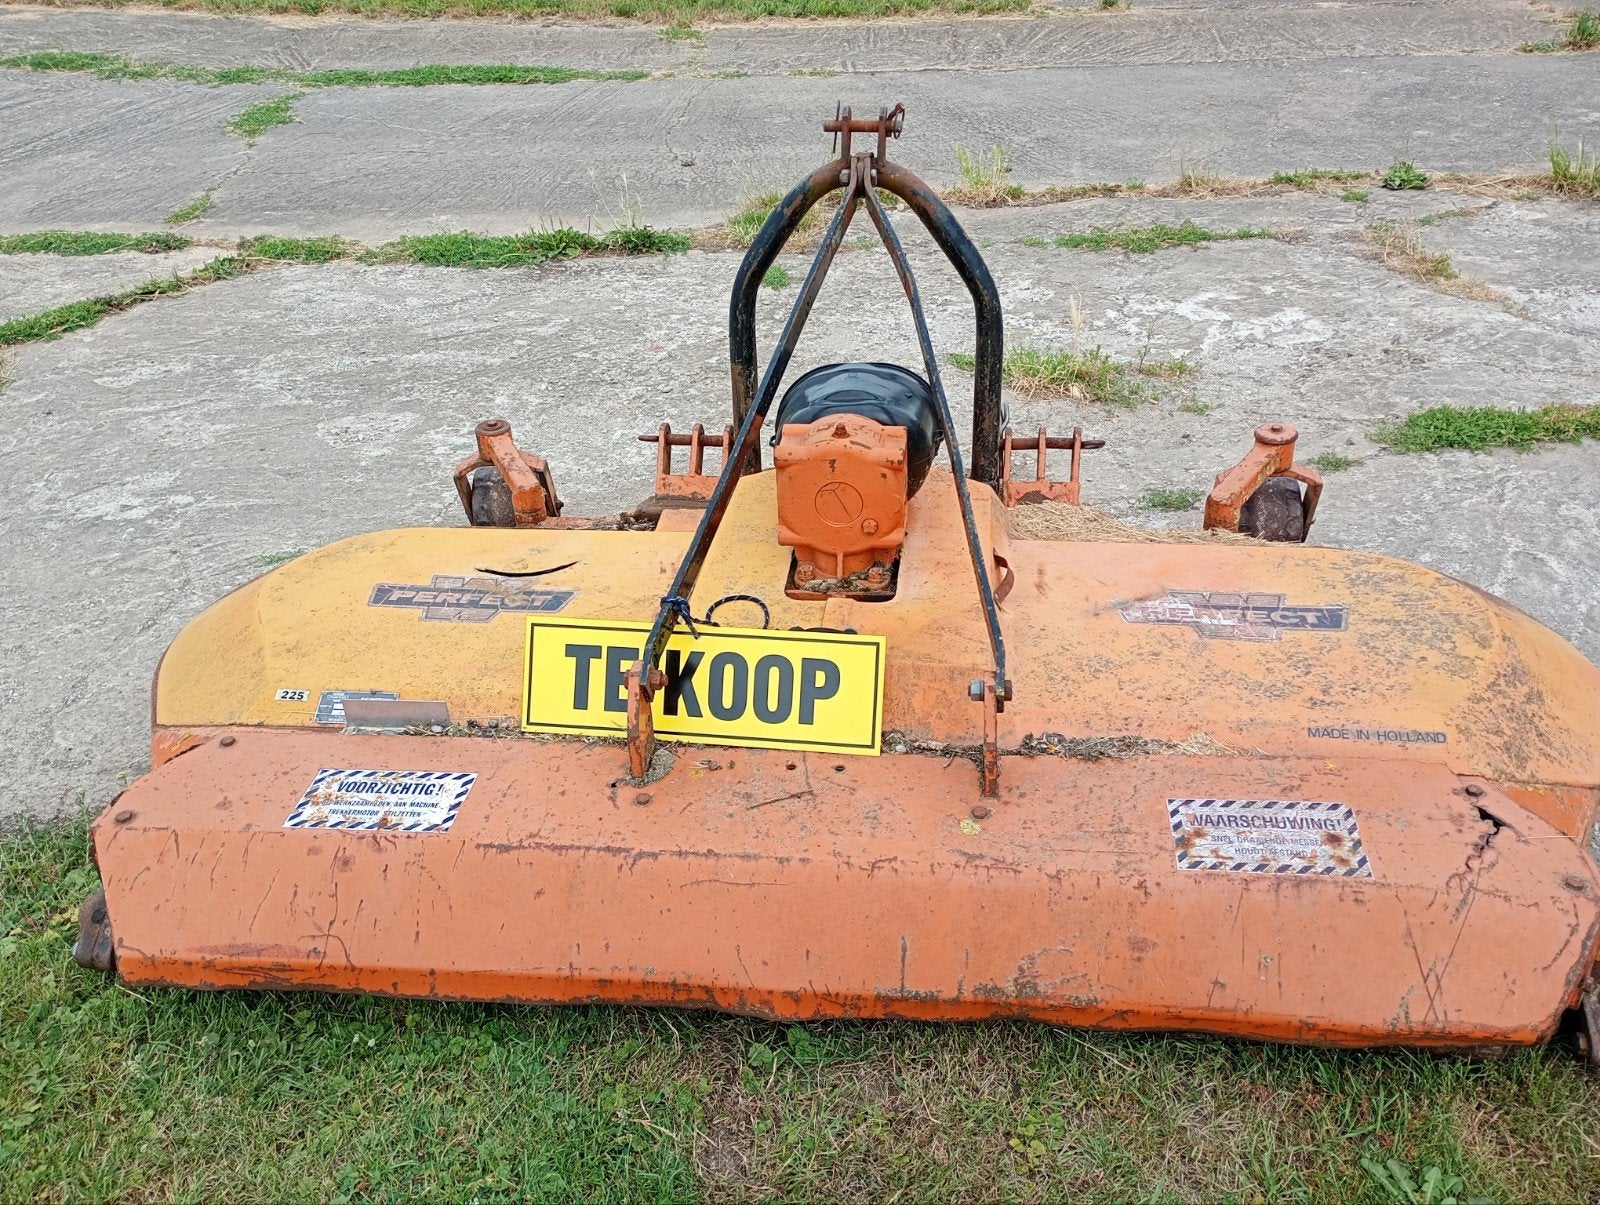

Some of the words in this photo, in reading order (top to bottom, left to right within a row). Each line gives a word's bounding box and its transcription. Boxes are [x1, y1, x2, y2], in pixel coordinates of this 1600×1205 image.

[565, 643, 643, 713] TE
[662, 649, 841, 726] KOOP
[281, 690, 304, 701] 225
[1307, 727, 1350, 740] MADE
[1356, 729, 1370, 740] IN
[1377, 730, 1447, 744] HOLLAND
[337, 780, 444, 796] VOORZICHTIG!
[409, 801, 440, 809] MACHINE
[1188, 814, 1344, 832] WAARSCHUWING!
